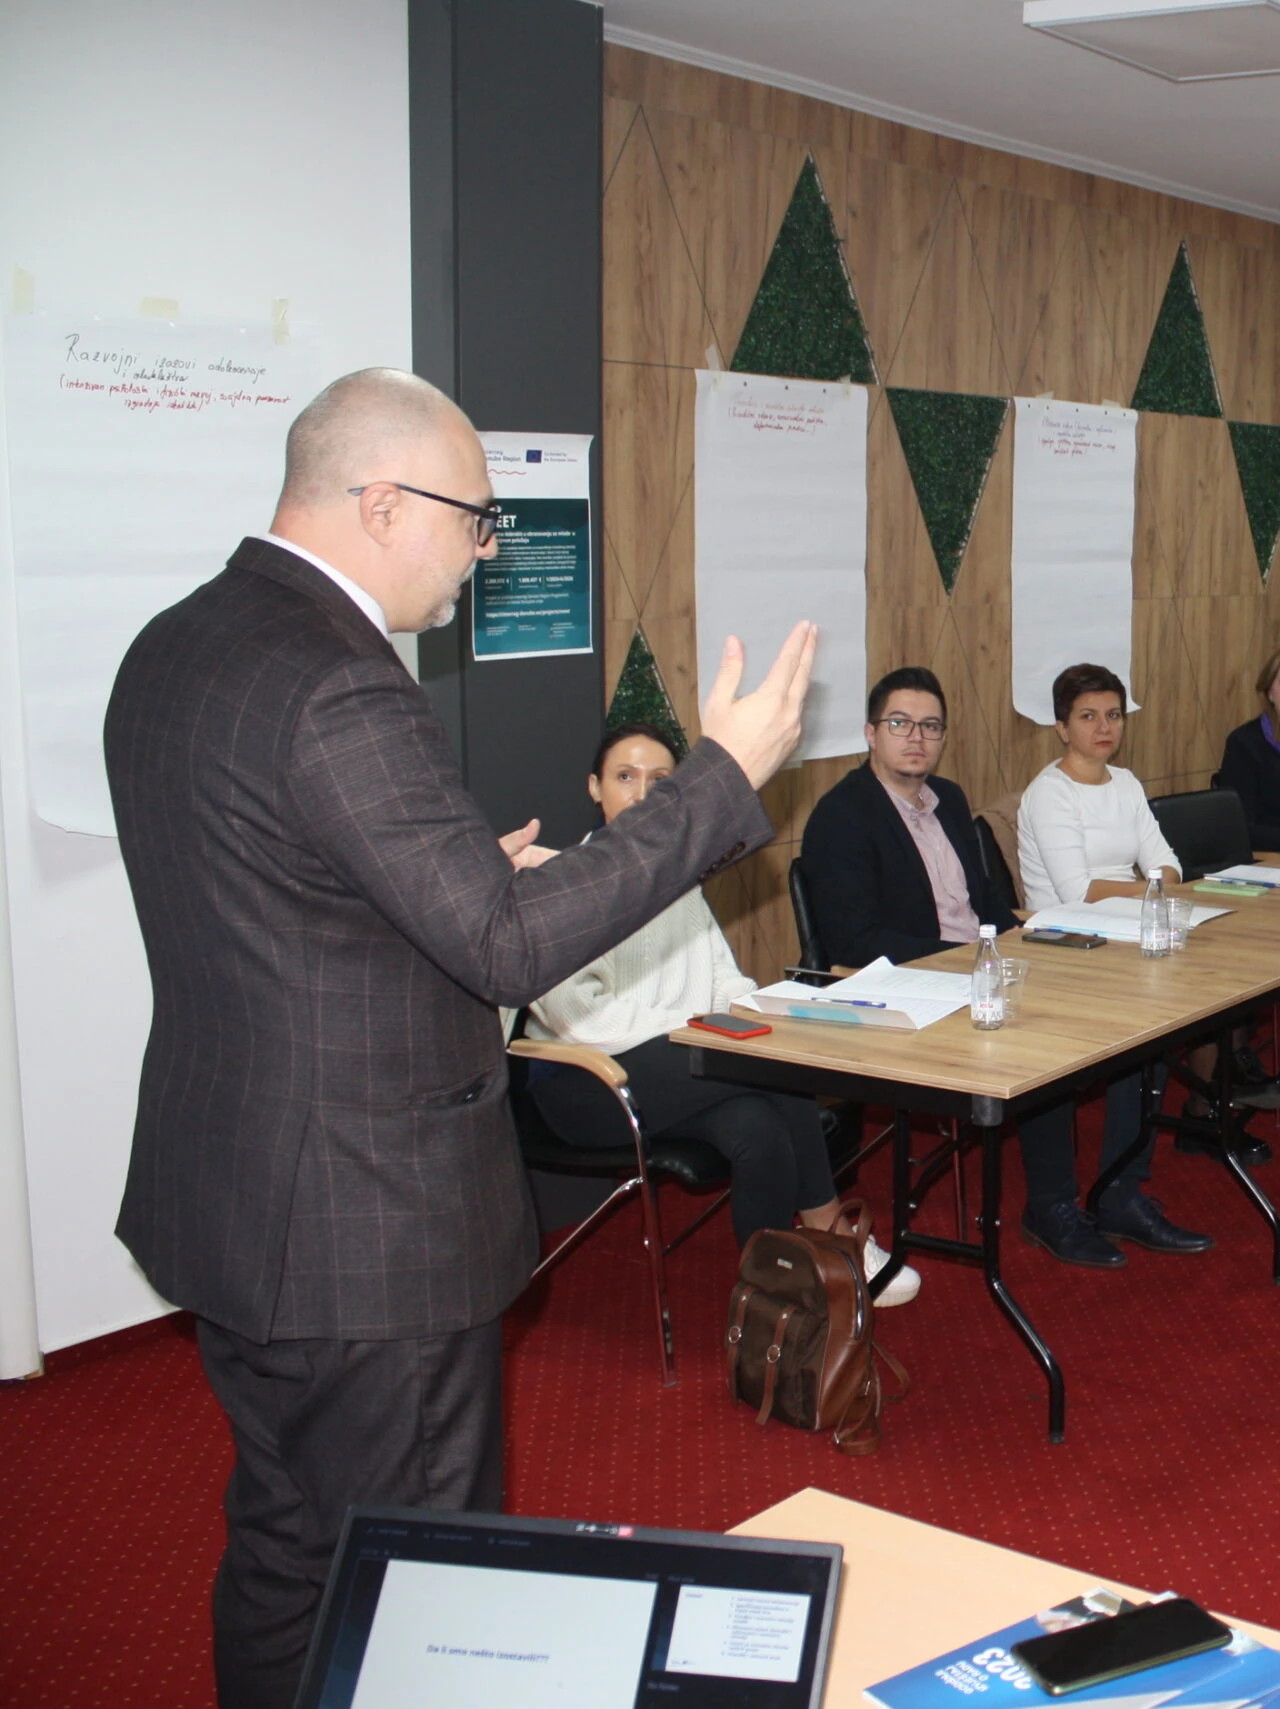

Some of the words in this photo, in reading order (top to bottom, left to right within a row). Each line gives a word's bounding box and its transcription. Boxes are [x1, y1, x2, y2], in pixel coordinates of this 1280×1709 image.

[65, 333, 137, 375] Razvojni
[496, 515, 517, 528] EET
[973, 1646, 1032, 1690] 2023
